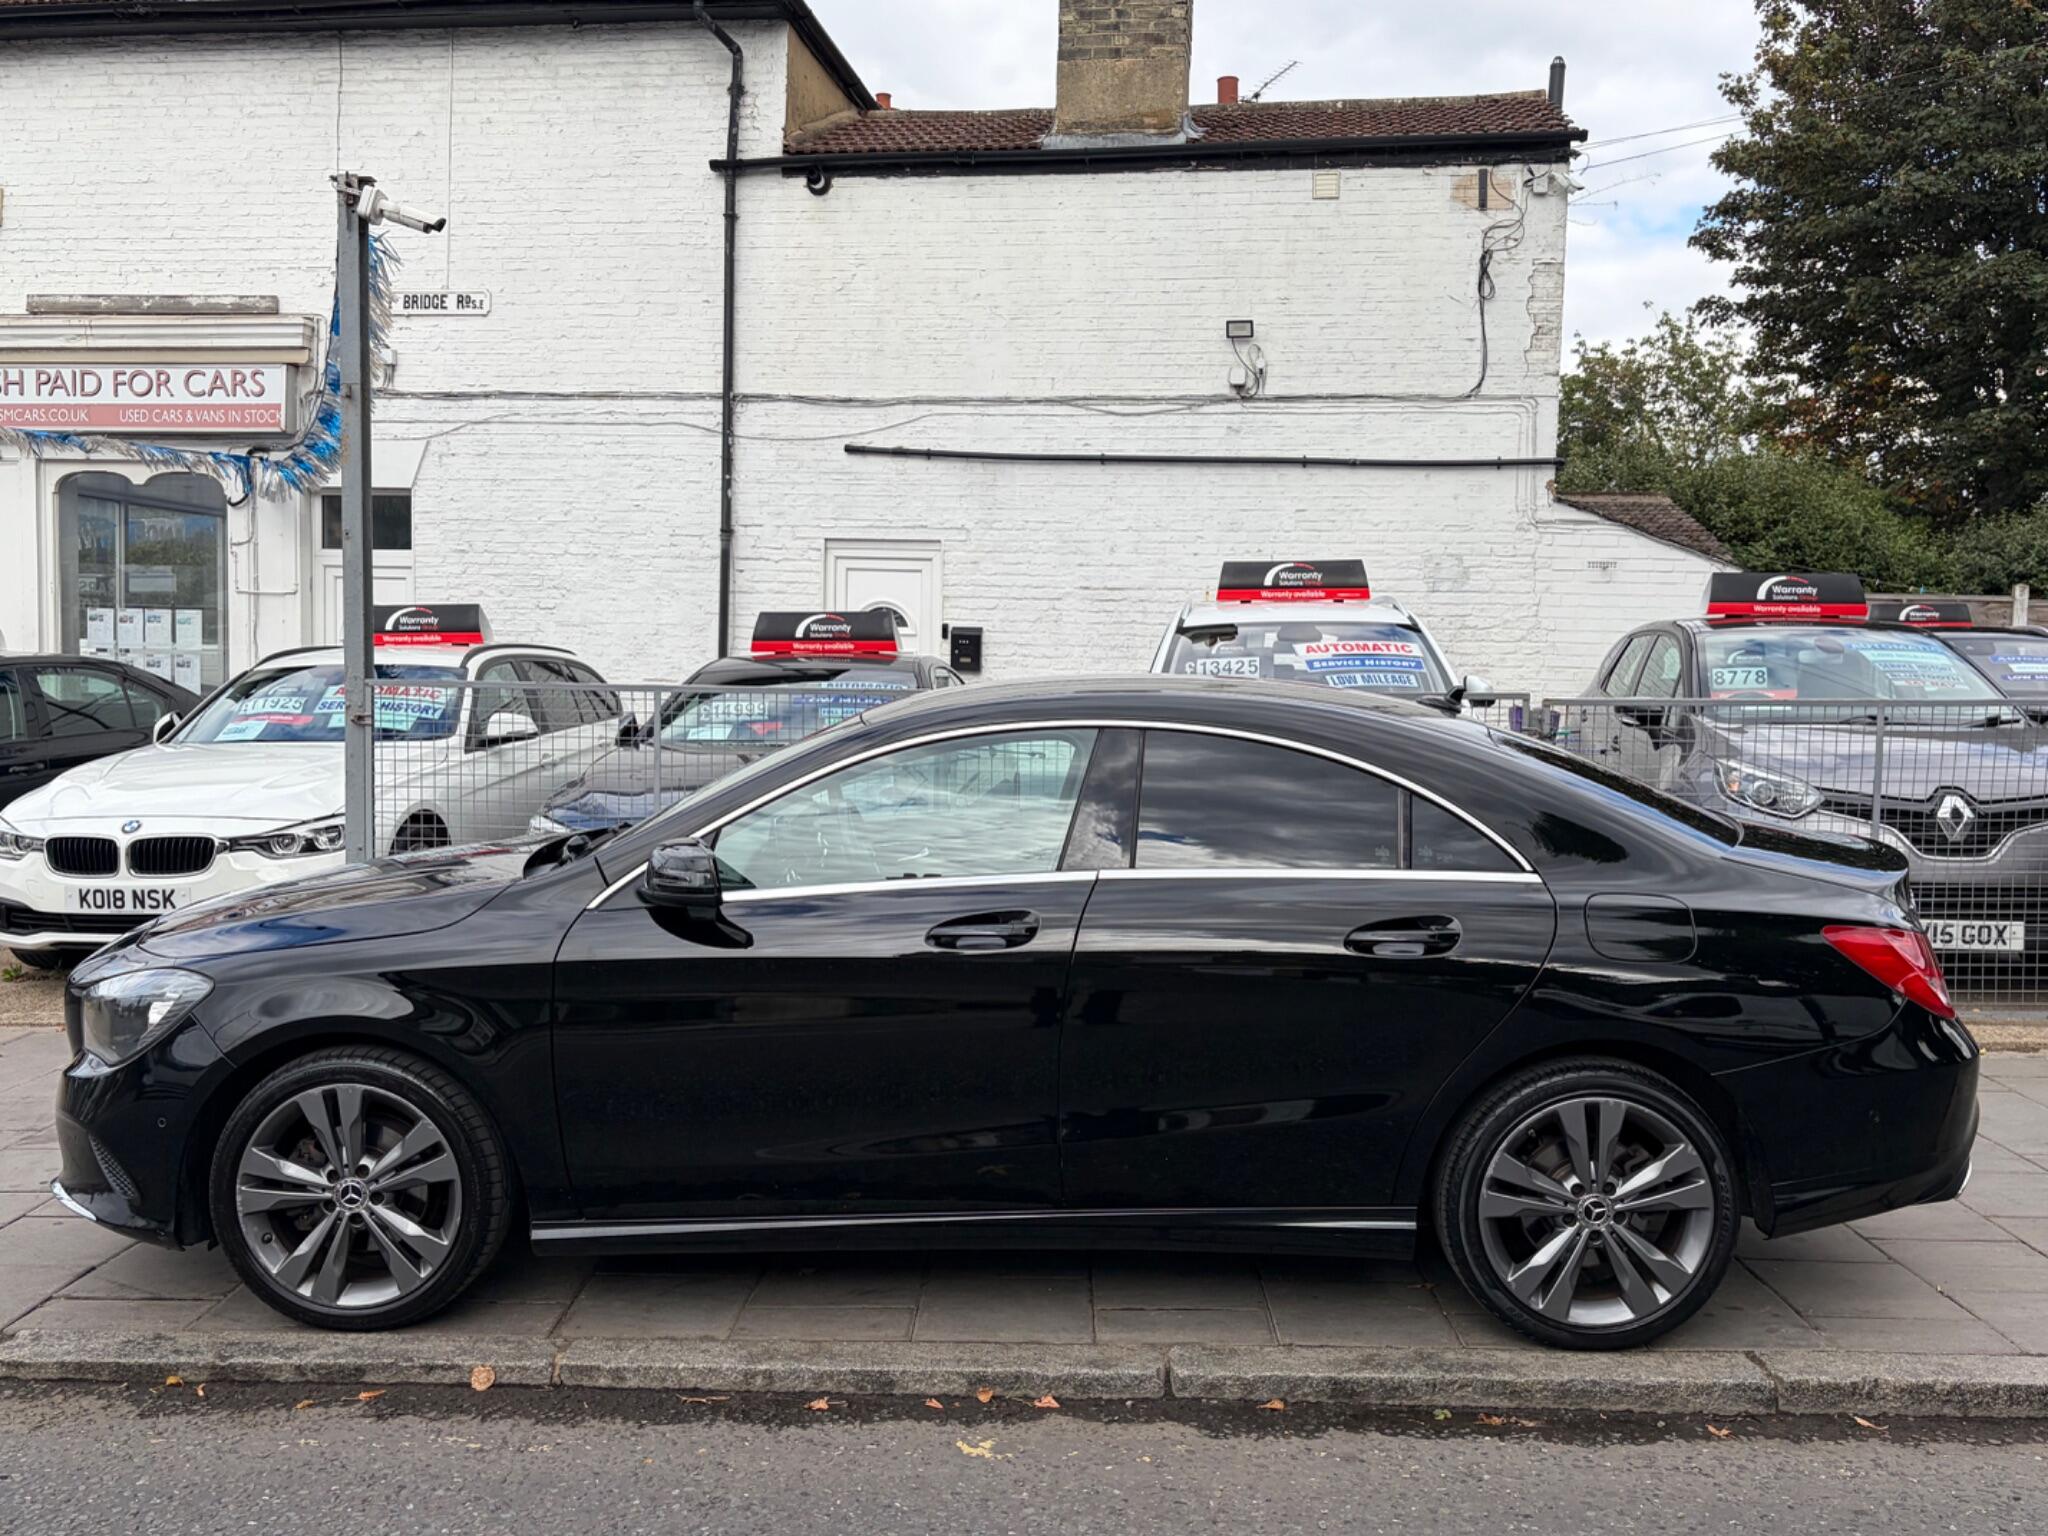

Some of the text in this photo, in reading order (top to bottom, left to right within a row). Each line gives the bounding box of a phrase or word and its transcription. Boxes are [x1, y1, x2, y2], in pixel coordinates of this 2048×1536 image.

[403, 294, 448, 310] BRIDGE
[0, 369, 266, 397] H PAID FOR CARS
[119, 409, 149, 422] USED
[152, 409, 183, 422] CARS
[185, 409, 193, 422] &
[195, 409, 225, 422] VANS
[228, 409, 240, 422] IN
[1279, 572, 1323, 581] Warranty
[1261, 590, 1293, 598] Warranty
[1772, 585, 1818, 595] Warranty
[1754, 605, 1786, 613] Warranty
[400, 616, 439, 625] Warranty
[810, 623, 851, 632] Warranty
[382, 635, 411, 643] Warranty
[793, 642, 823, 650] Warranty
[1305, 642, 1413, 654] AUTOMATIC
[1313, 660, 1417, 668] SERVICE HISTORY
[1331, 673, 1415, 685] LOW MILEAGE
[1714, 670, 1766, 685] 8778
[380, 701, 442, 717] HISTORY
[79, 888, 176, 910] KO18 NSK
[1961, 924, 2008, 946] GOX
